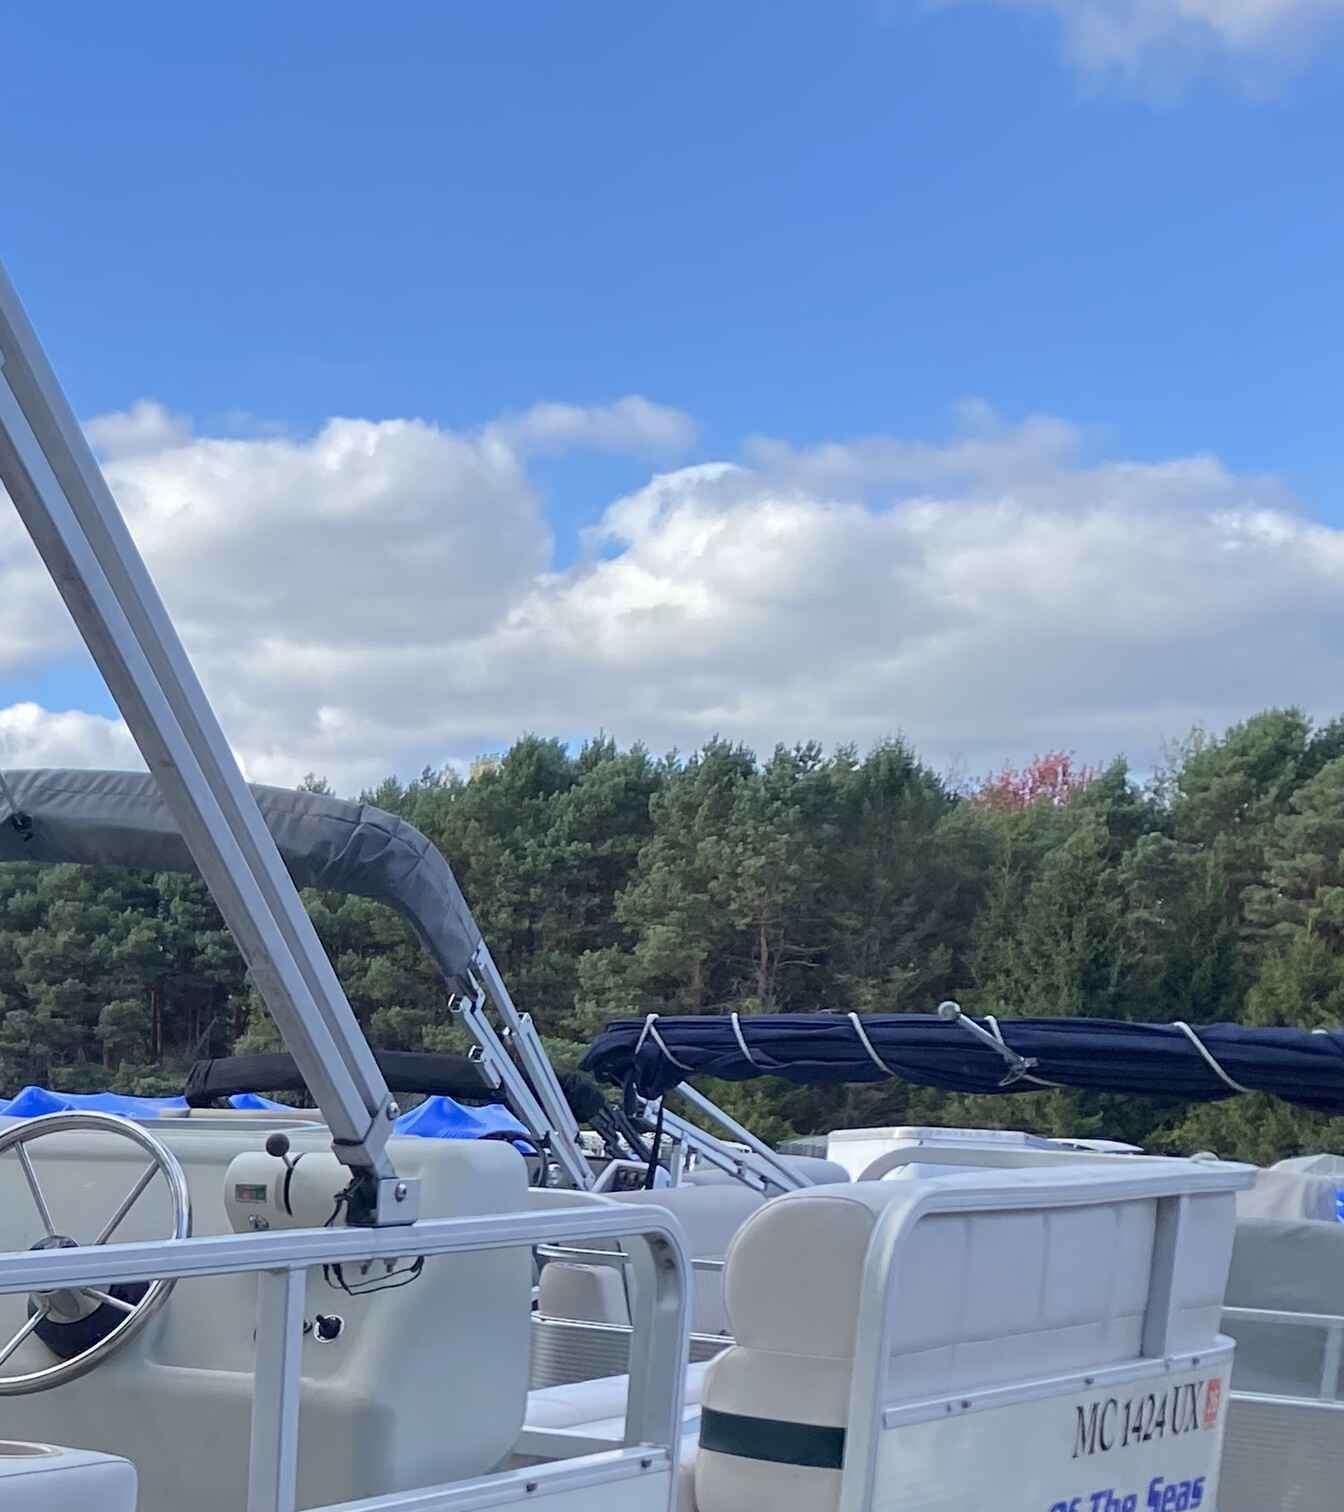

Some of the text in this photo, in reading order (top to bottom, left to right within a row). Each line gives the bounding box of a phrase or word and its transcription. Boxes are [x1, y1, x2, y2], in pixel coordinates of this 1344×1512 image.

[1072, 1398, 1118, 1458] MC
[1122, 1393, 1168, 1447] 1424
[1172, 1381, 1204, 1434] UX
